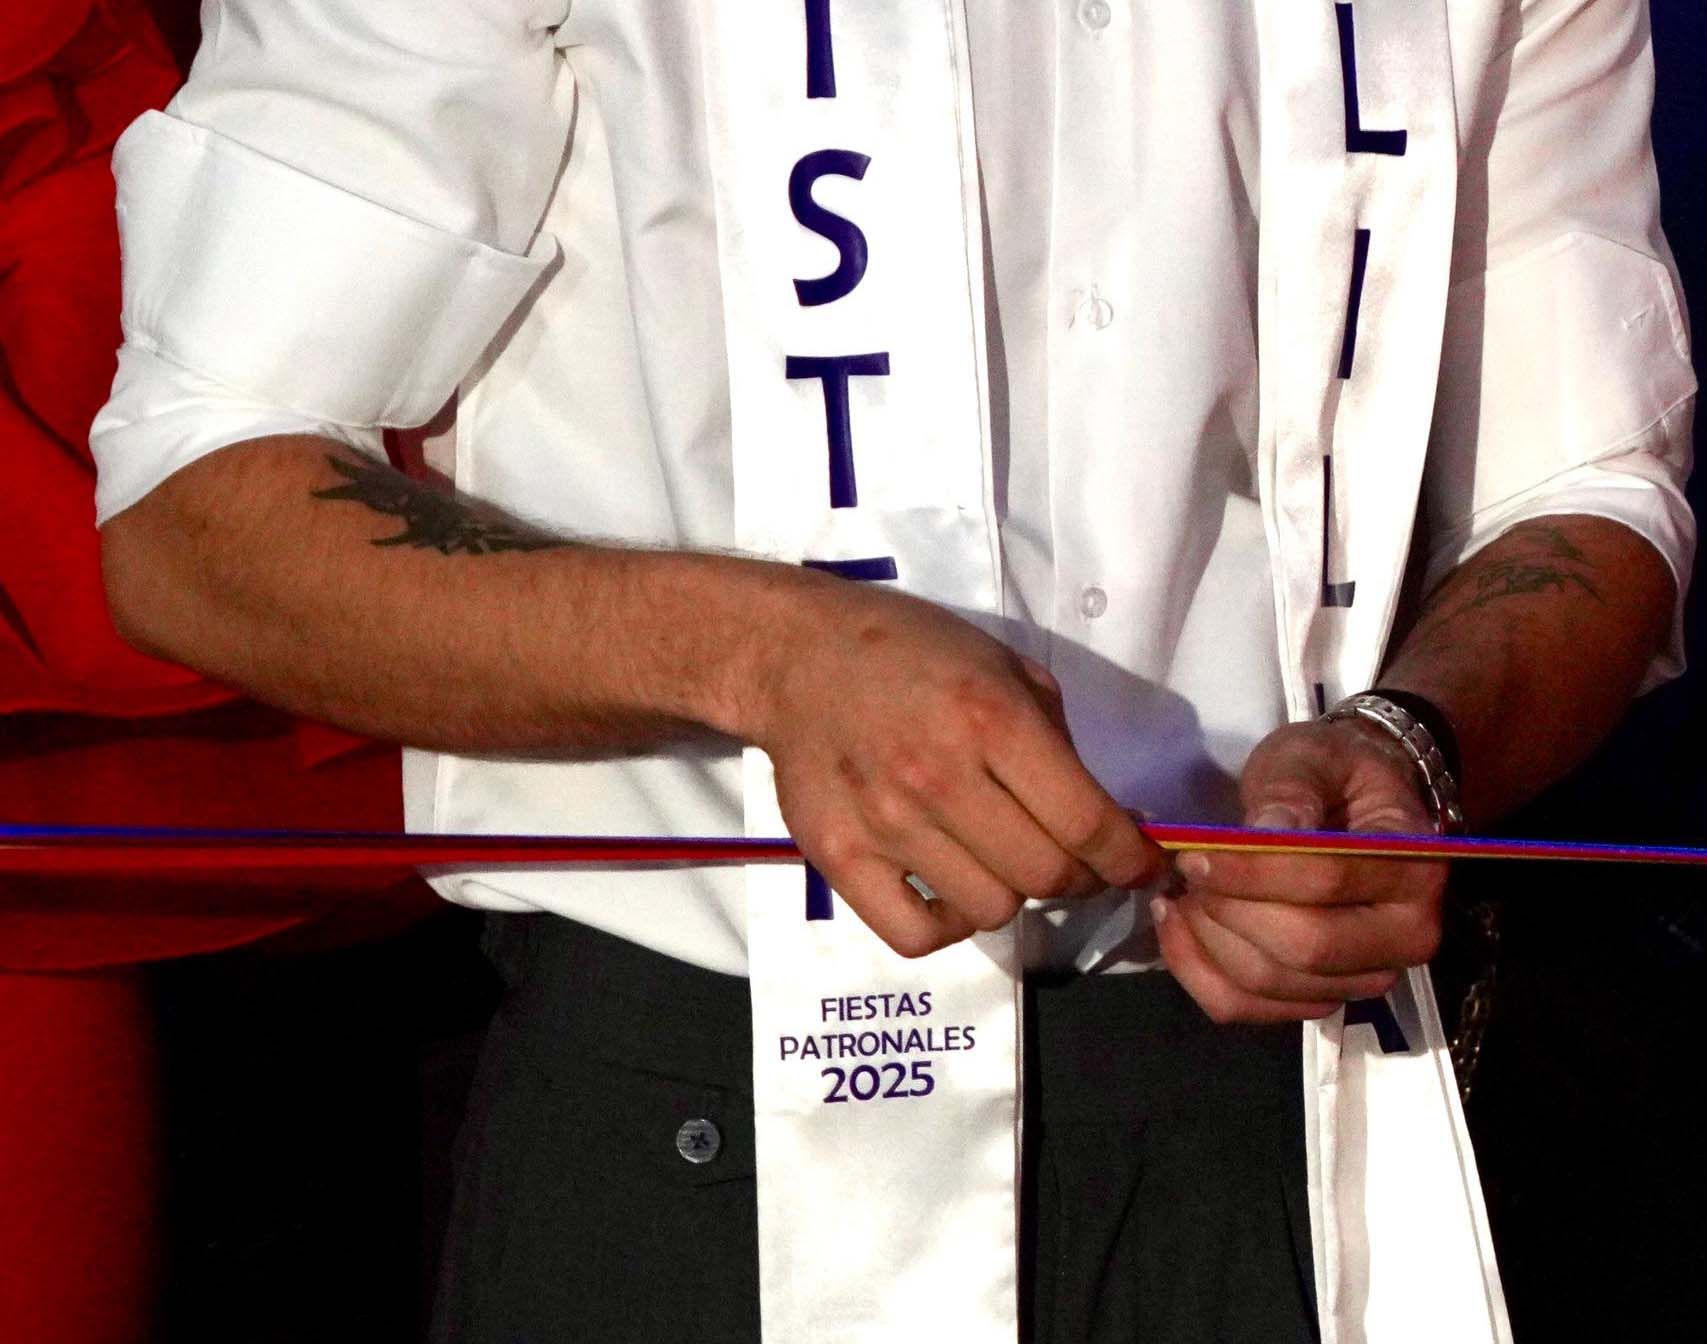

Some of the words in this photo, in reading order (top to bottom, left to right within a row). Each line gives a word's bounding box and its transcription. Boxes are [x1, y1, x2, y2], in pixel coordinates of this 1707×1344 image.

[820, 991, 933, 1023] FIESTAS
[779, 1025, 976, 1062] PATRONALES
[820, 1060, 936, 1104] 2025
